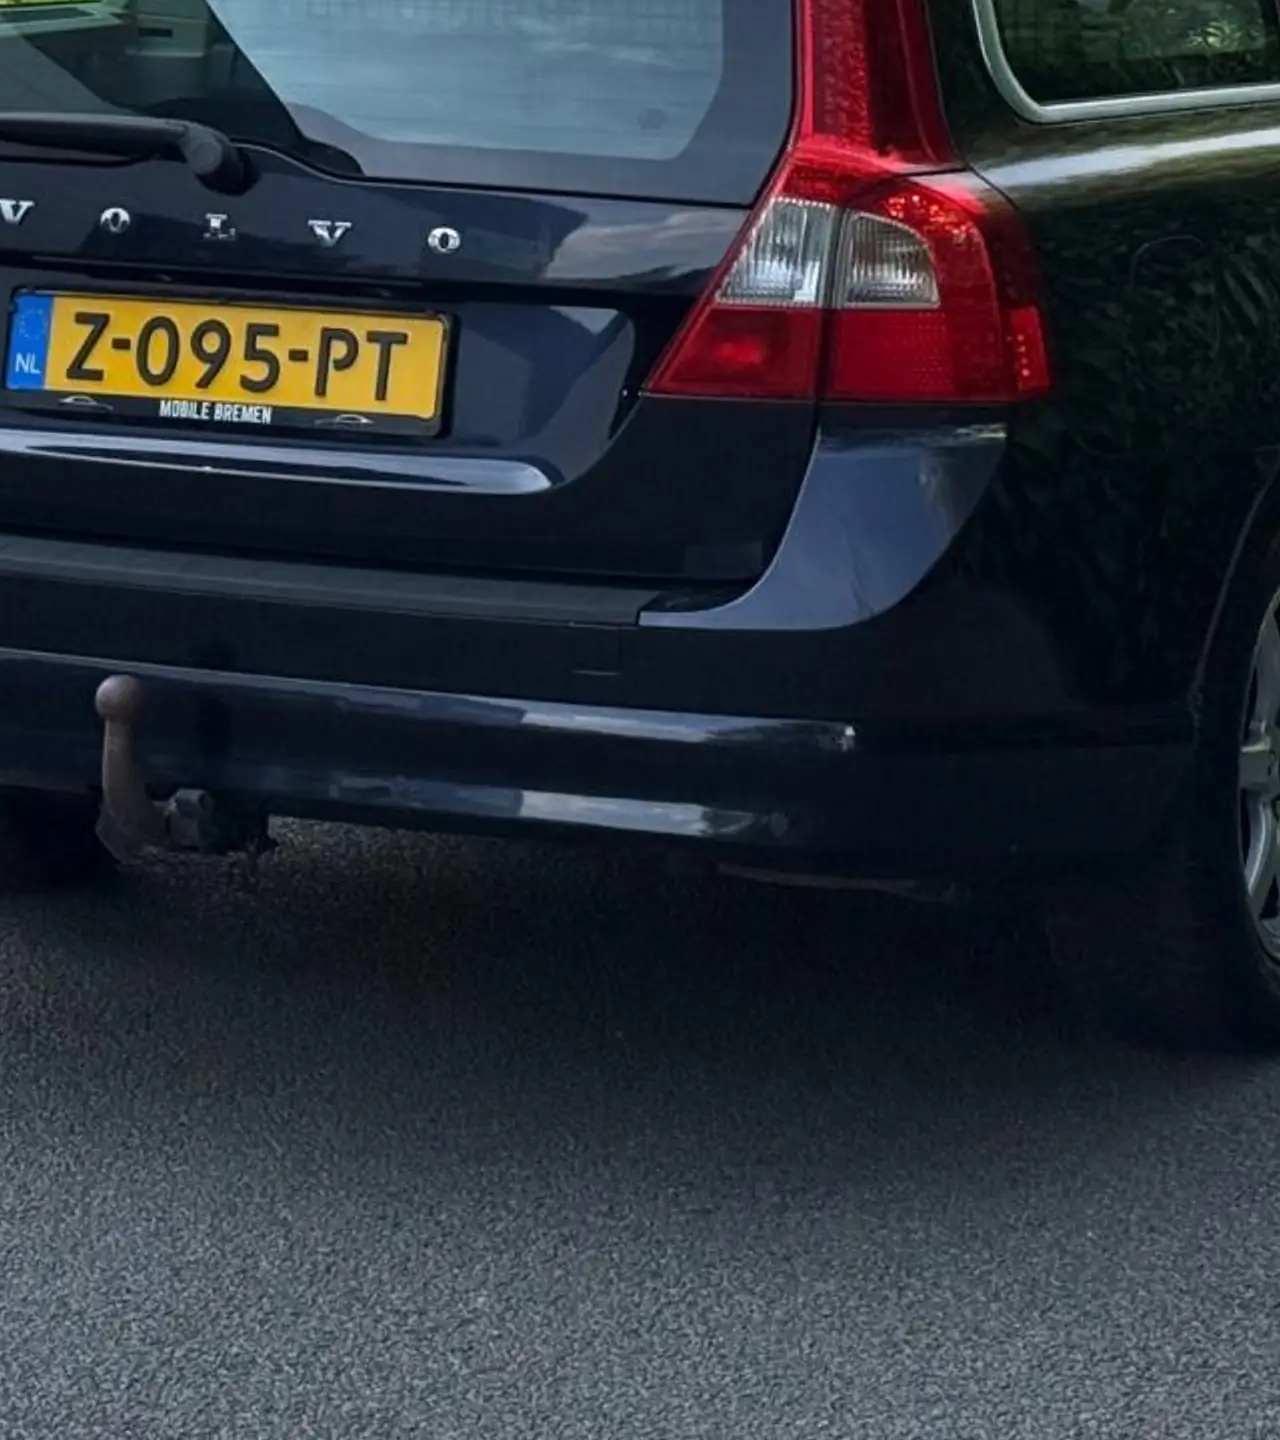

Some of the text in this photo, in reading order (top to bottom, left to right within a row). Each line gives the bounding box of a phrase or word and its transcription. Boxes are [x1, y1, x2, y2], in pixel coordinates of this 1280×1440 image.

[15, 353, 41, 375] NL
[65, 312, 409, 401] Z-095-PT
[159, 400, 273, 424] MOBILE BREMEN
